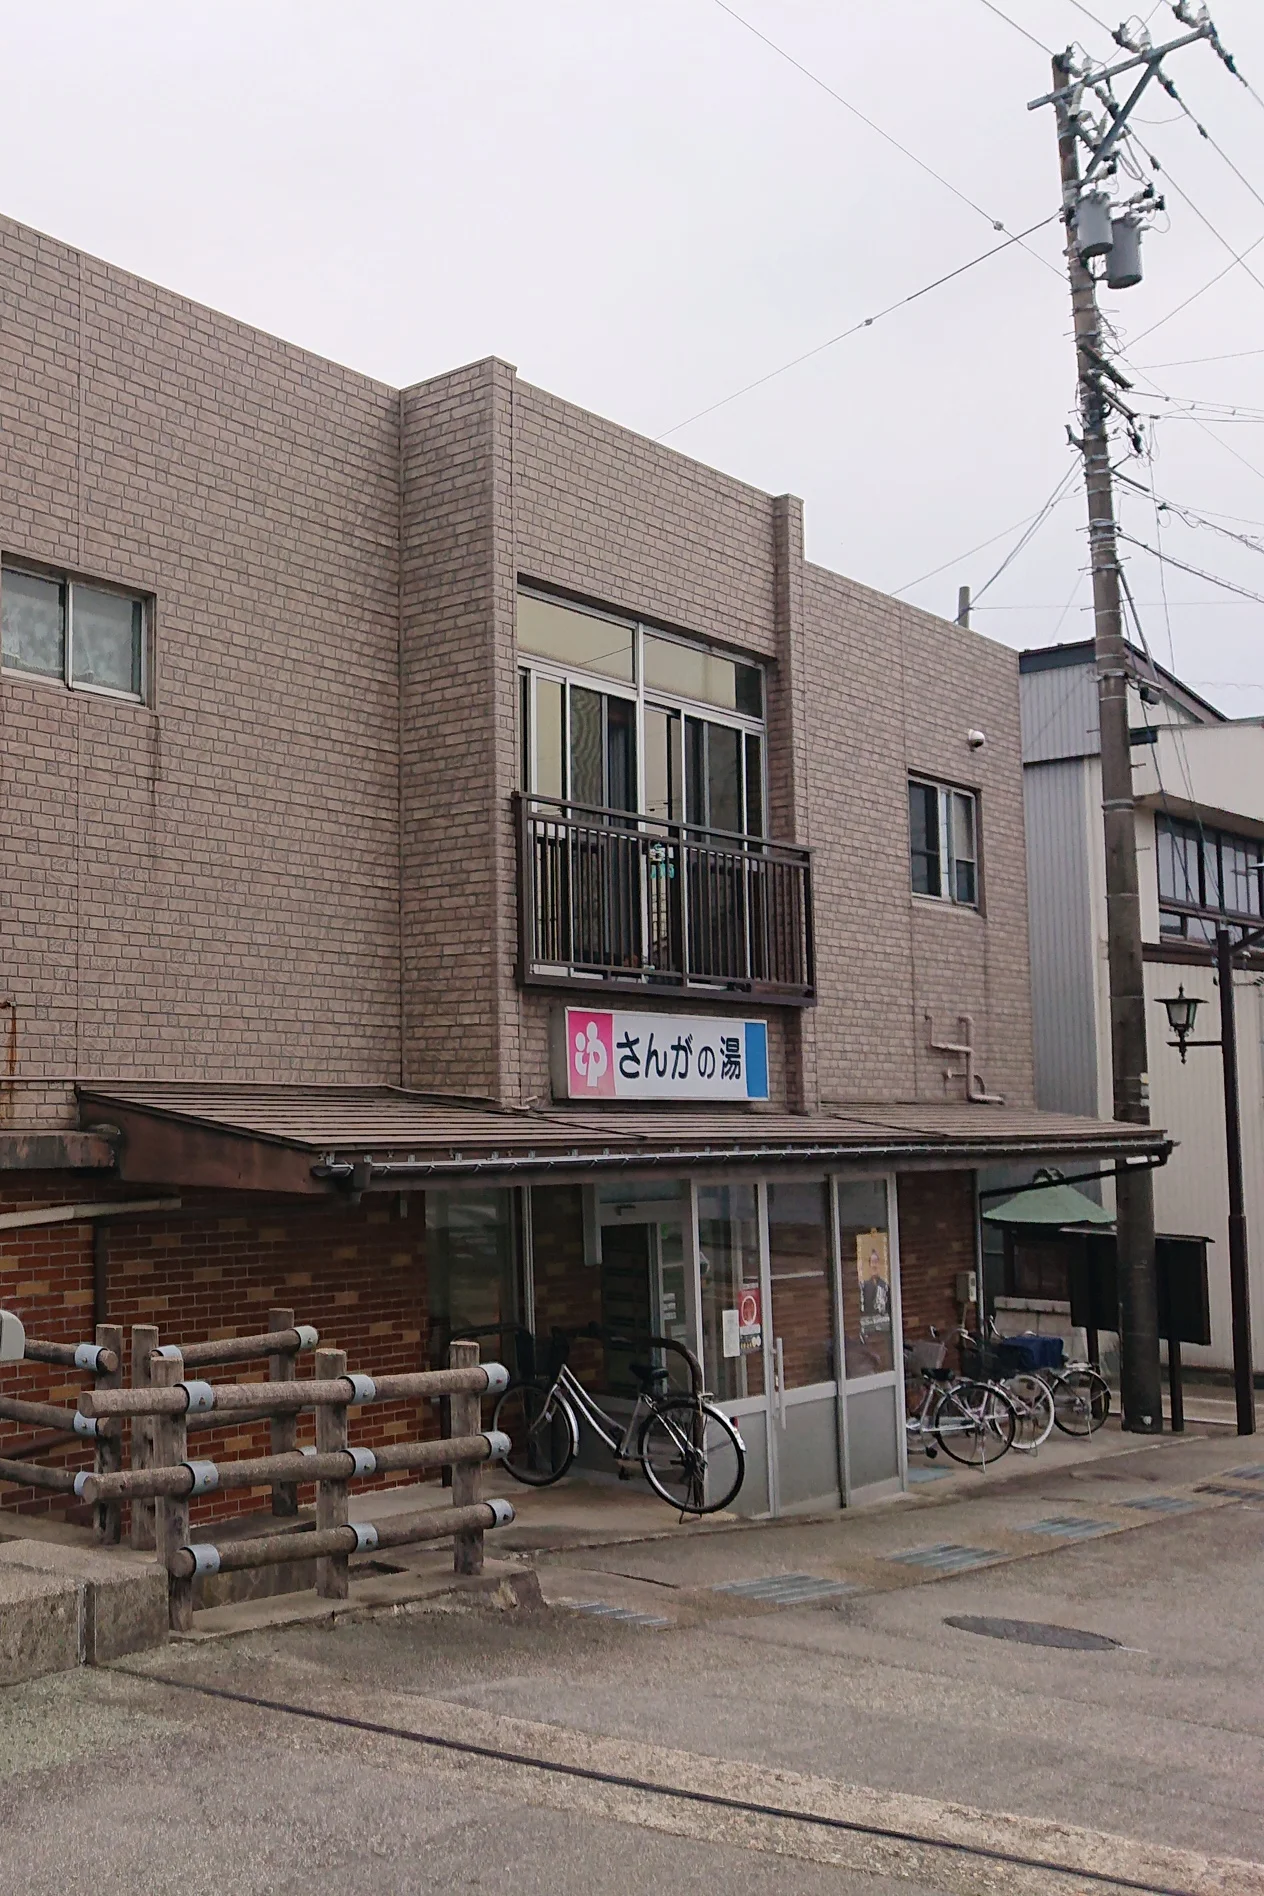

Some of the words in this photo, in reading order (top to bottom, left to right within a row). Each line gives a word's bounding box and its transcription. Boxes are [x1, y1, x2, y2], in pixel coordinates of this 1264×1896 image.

[616, 1031, 742, 1081] さんがの湯
